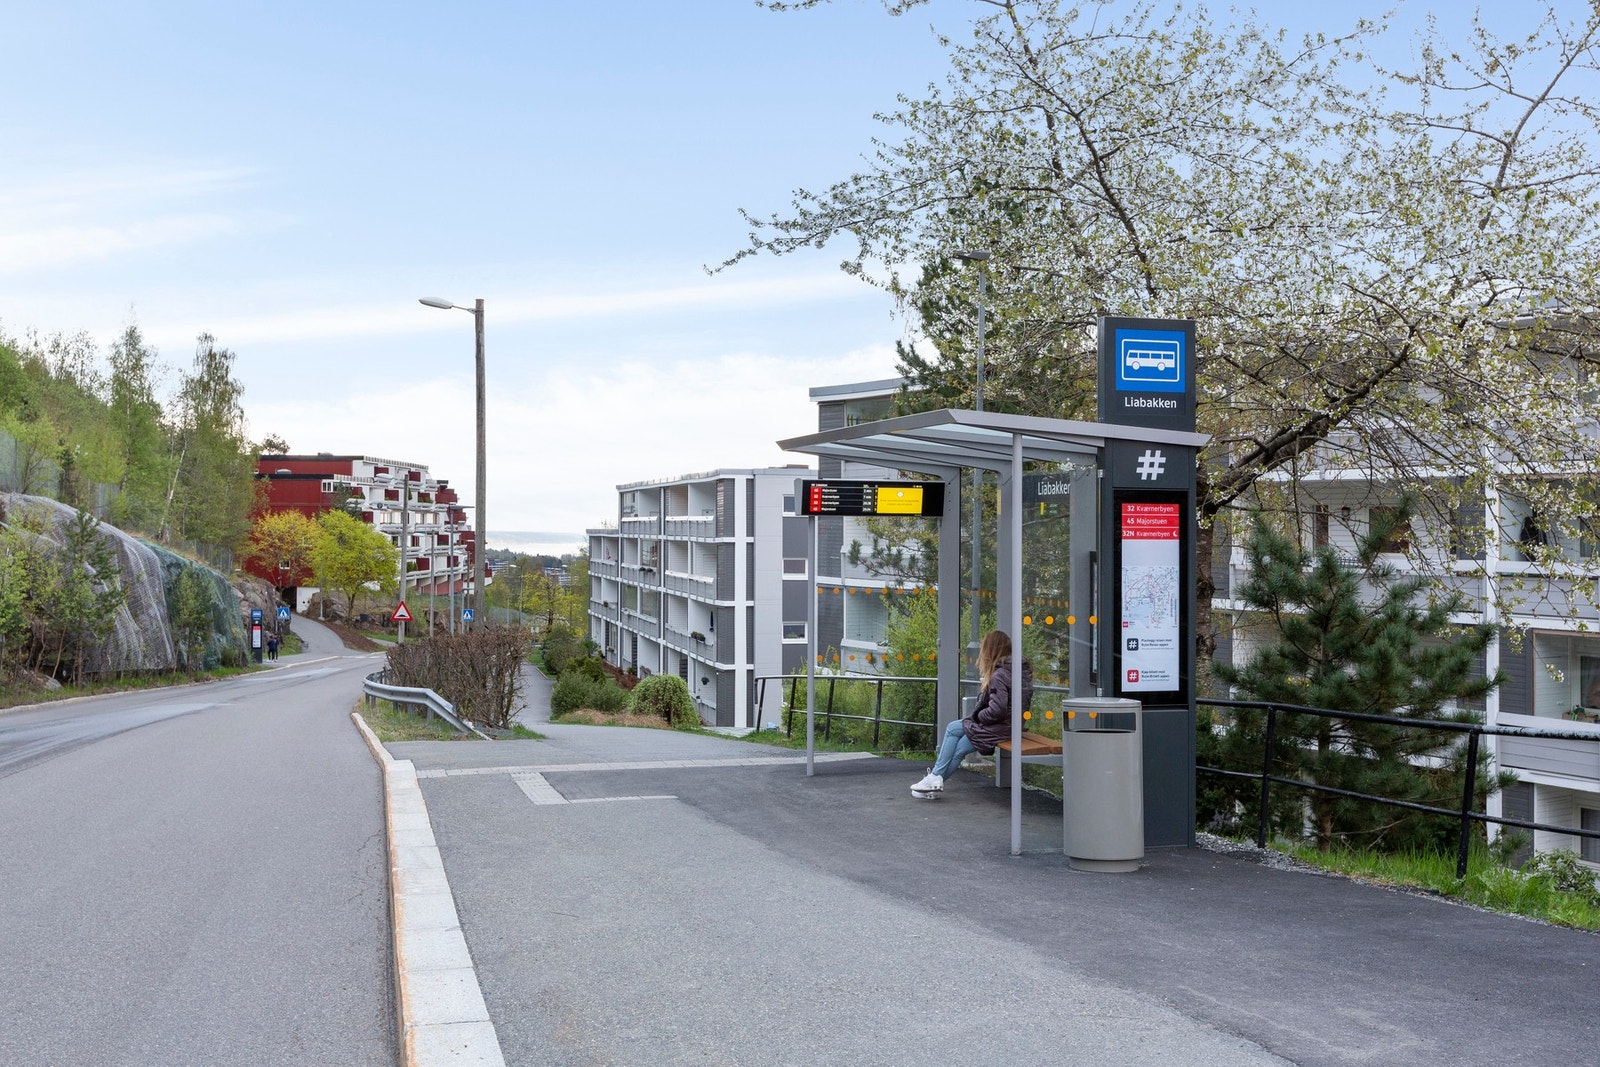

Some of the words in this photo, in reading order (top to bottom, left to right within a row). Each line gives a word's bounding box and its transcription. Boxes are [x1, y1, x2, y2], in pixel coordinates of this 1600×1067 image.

[1124, 397, 1177, 408] Liabakken
[1136, 505, 1174, 513] Kværnerbyen
[1136, 530, 1171, 538] Kværnerbyen
